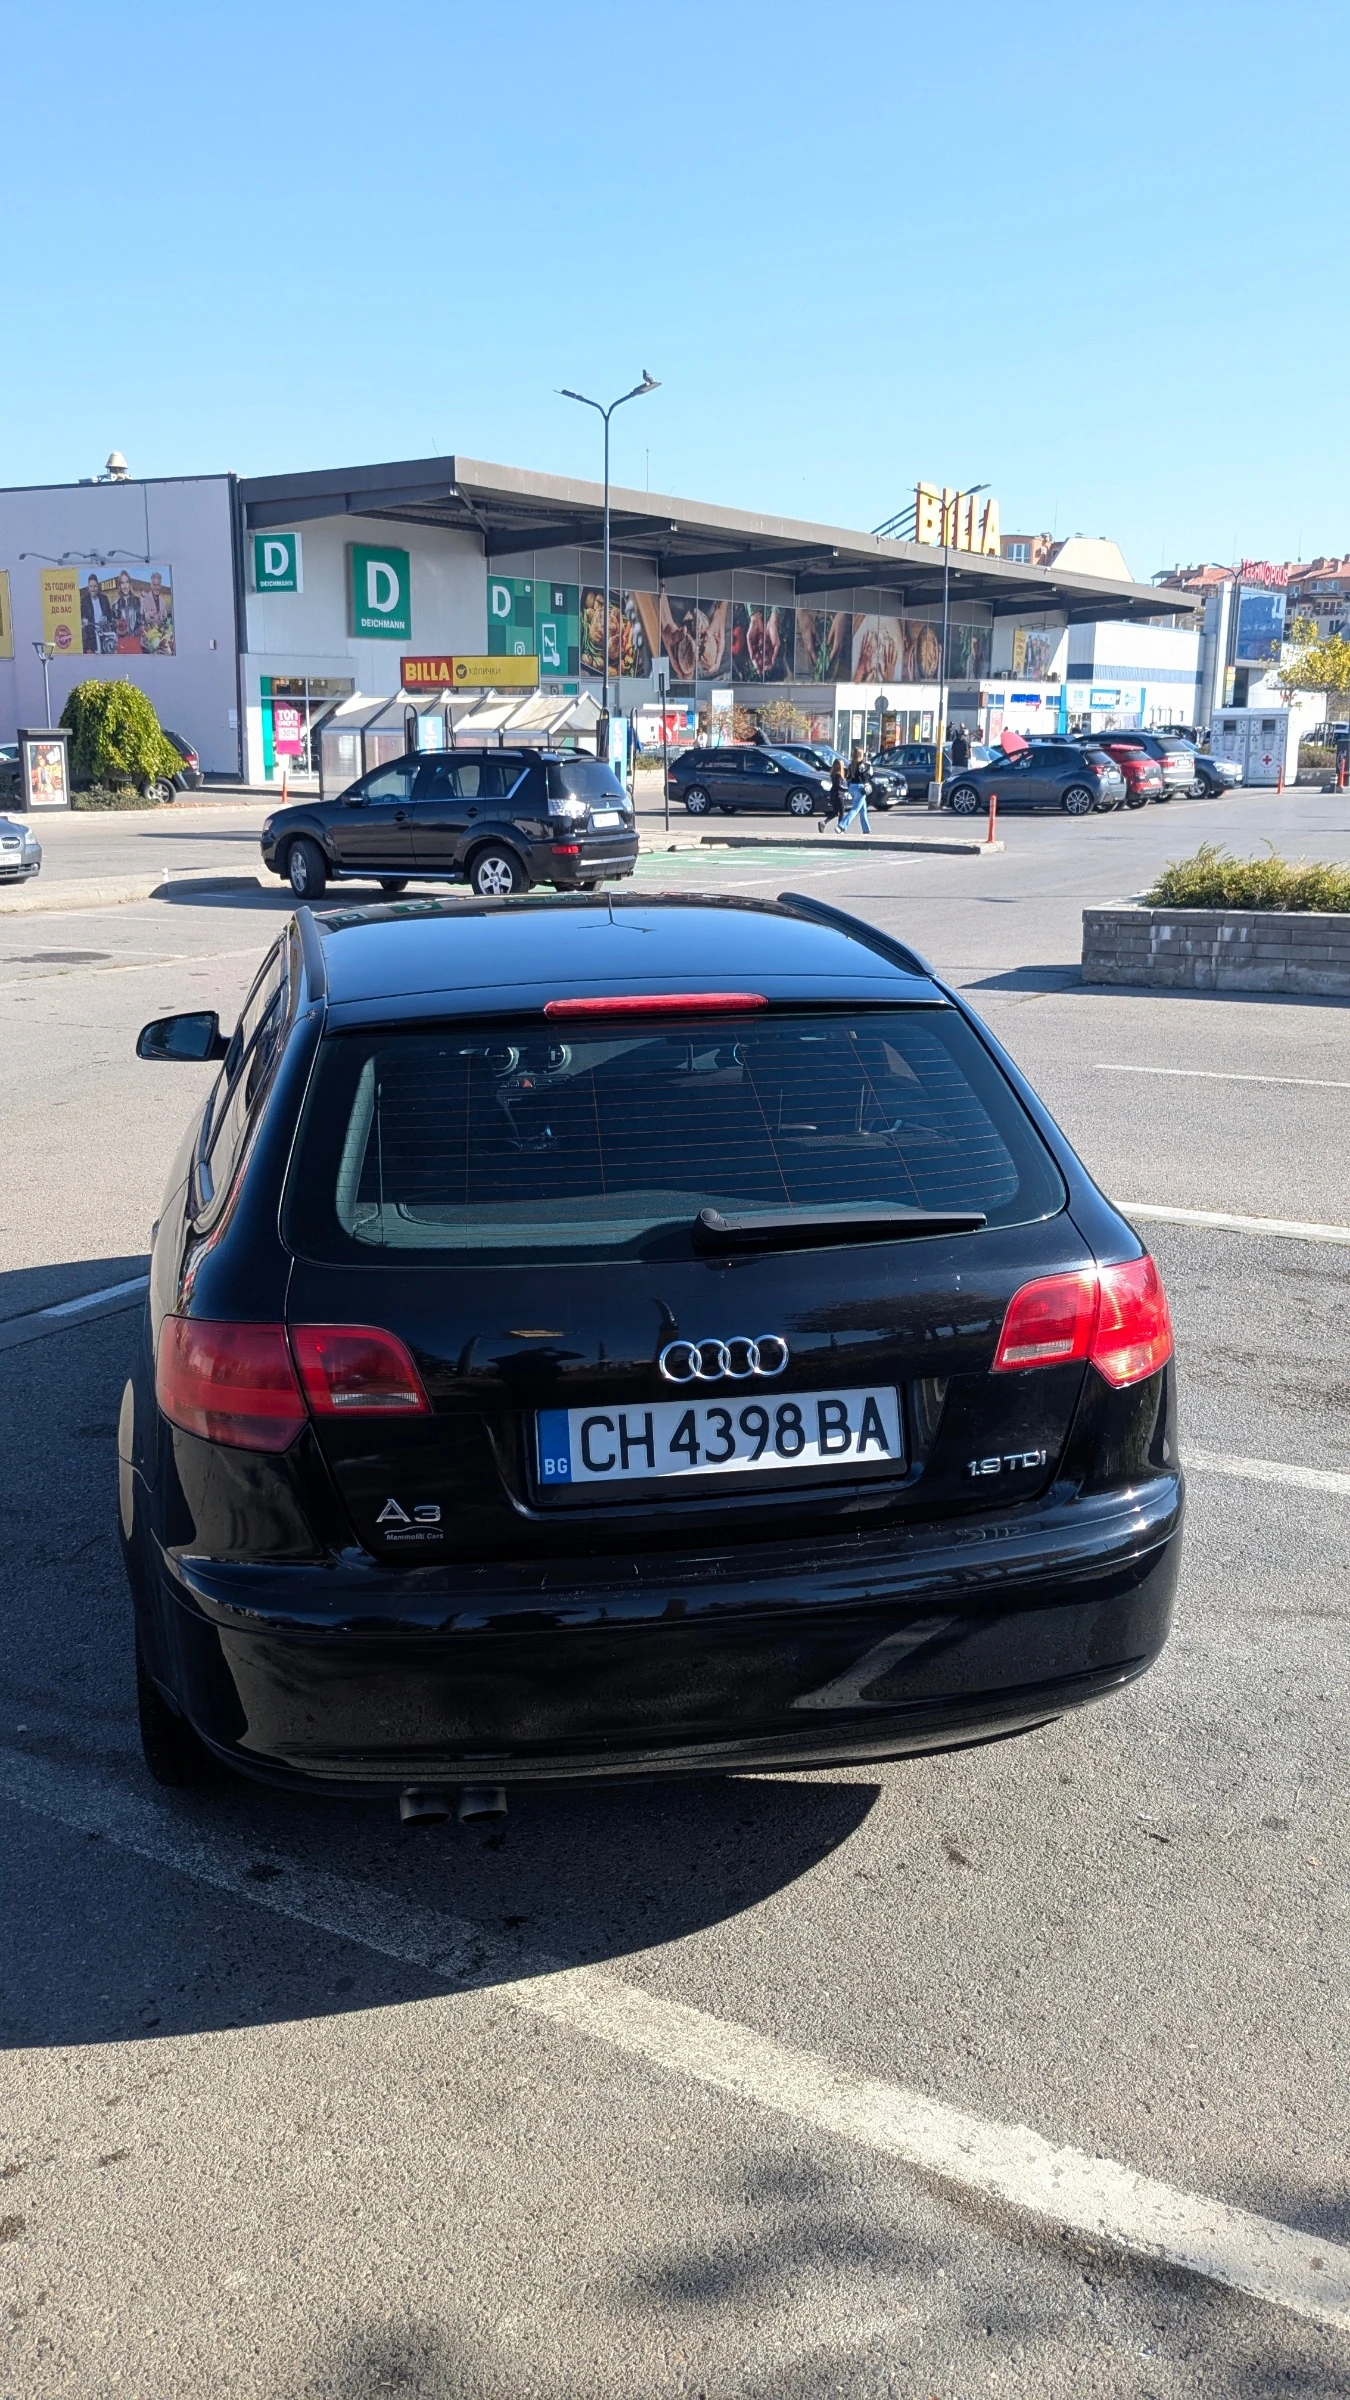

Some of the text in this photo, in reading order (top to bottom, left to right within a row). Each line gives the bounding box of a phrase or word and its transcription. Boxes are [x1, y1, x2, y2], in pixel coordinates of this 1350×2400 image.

[915, 482, 1001, 557] BILLA
[264, 542, 289, 577] D
[1241, 558, 1289, 587] TECHNOPOLIS
[44, 582, 76, 592] 25 ГОДИНИ
[49, 594, 72, 603] ВИНАГИ
[366, 560, 400, 613] D
[51, 605, 72, 615] ДО ВАС
[492, 585, 511, 618] D
[361, 618, 405, 629] DEICHMANN
[405, 662, 450, 682] BILLA
[277, 709, 299, 721] ТОП
[580, 1396, 890, 1472] CH 4398 BA
[544, 1457, 568, 1475] BG
[967, 1449, 1047, 1476] 1.9 TDI
[375, 1498, 441, 1523] A3
